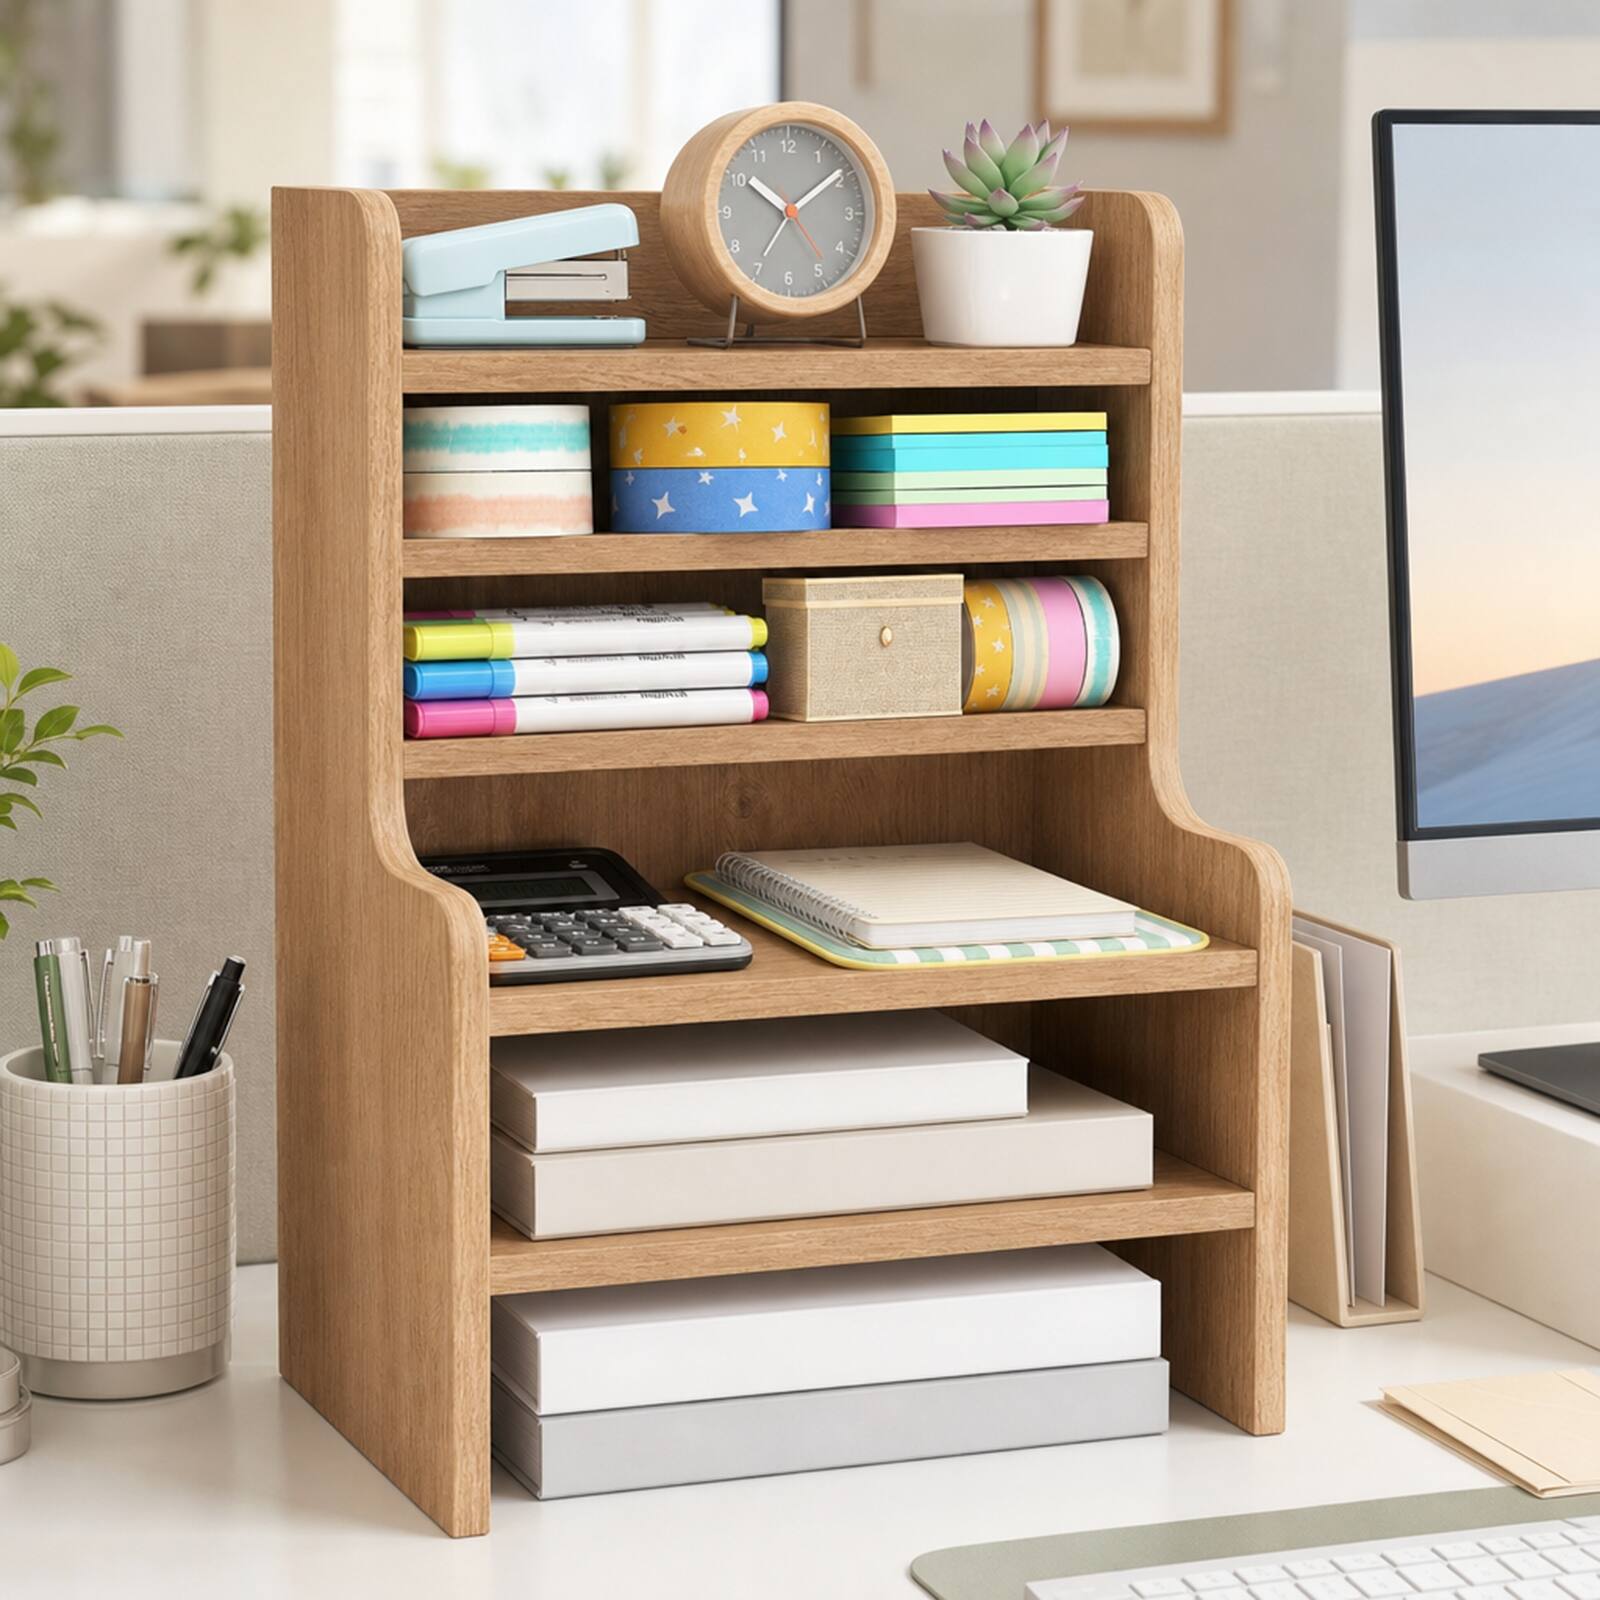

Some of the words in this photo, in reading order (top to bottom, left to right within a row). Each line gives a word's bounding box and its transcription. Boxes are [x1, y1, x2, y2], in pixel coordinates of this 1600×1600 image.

[780, 140, 797, 154] 12
[752, 150, 766, 163] 11
[815, 150, 821, 163] 1
[731, 173, 746, 187] 10
[835, 174, 844, 188] 2
[722, 206, 732, 219] 9
[844, 207, 854, 221] 3
[730, 239, 740, 253] 8
[835, 241, 844, 254] 4
[753, 263, 762, 275] 7
[814, 264, 823, 277] 5
[784, 272, 793, 285] 6
